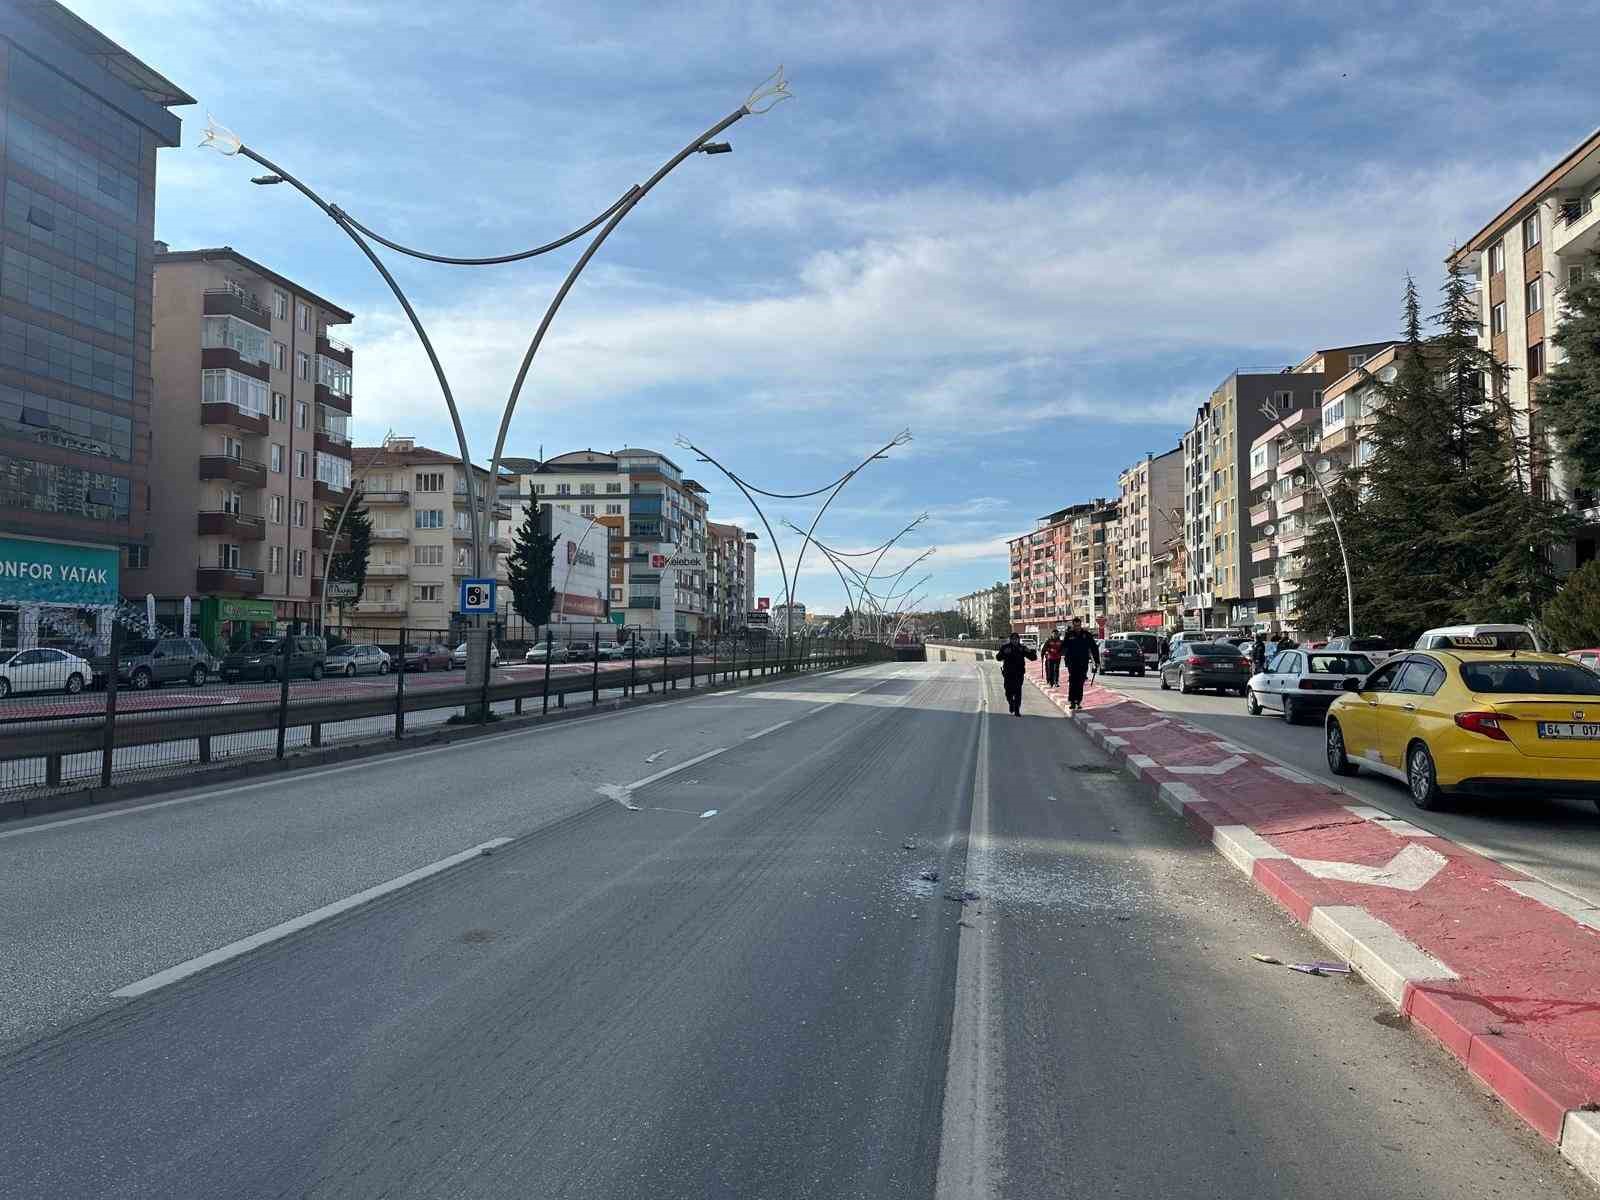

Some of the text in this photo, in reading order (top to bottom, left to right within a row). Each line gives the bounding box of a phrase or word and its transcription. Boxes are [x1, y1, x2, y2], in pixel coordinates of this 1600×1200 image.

[60, 565, 107, 584] YATAK
[1547, 724, 1560, 737] 64
[1569, 724, 1576, 735] T
